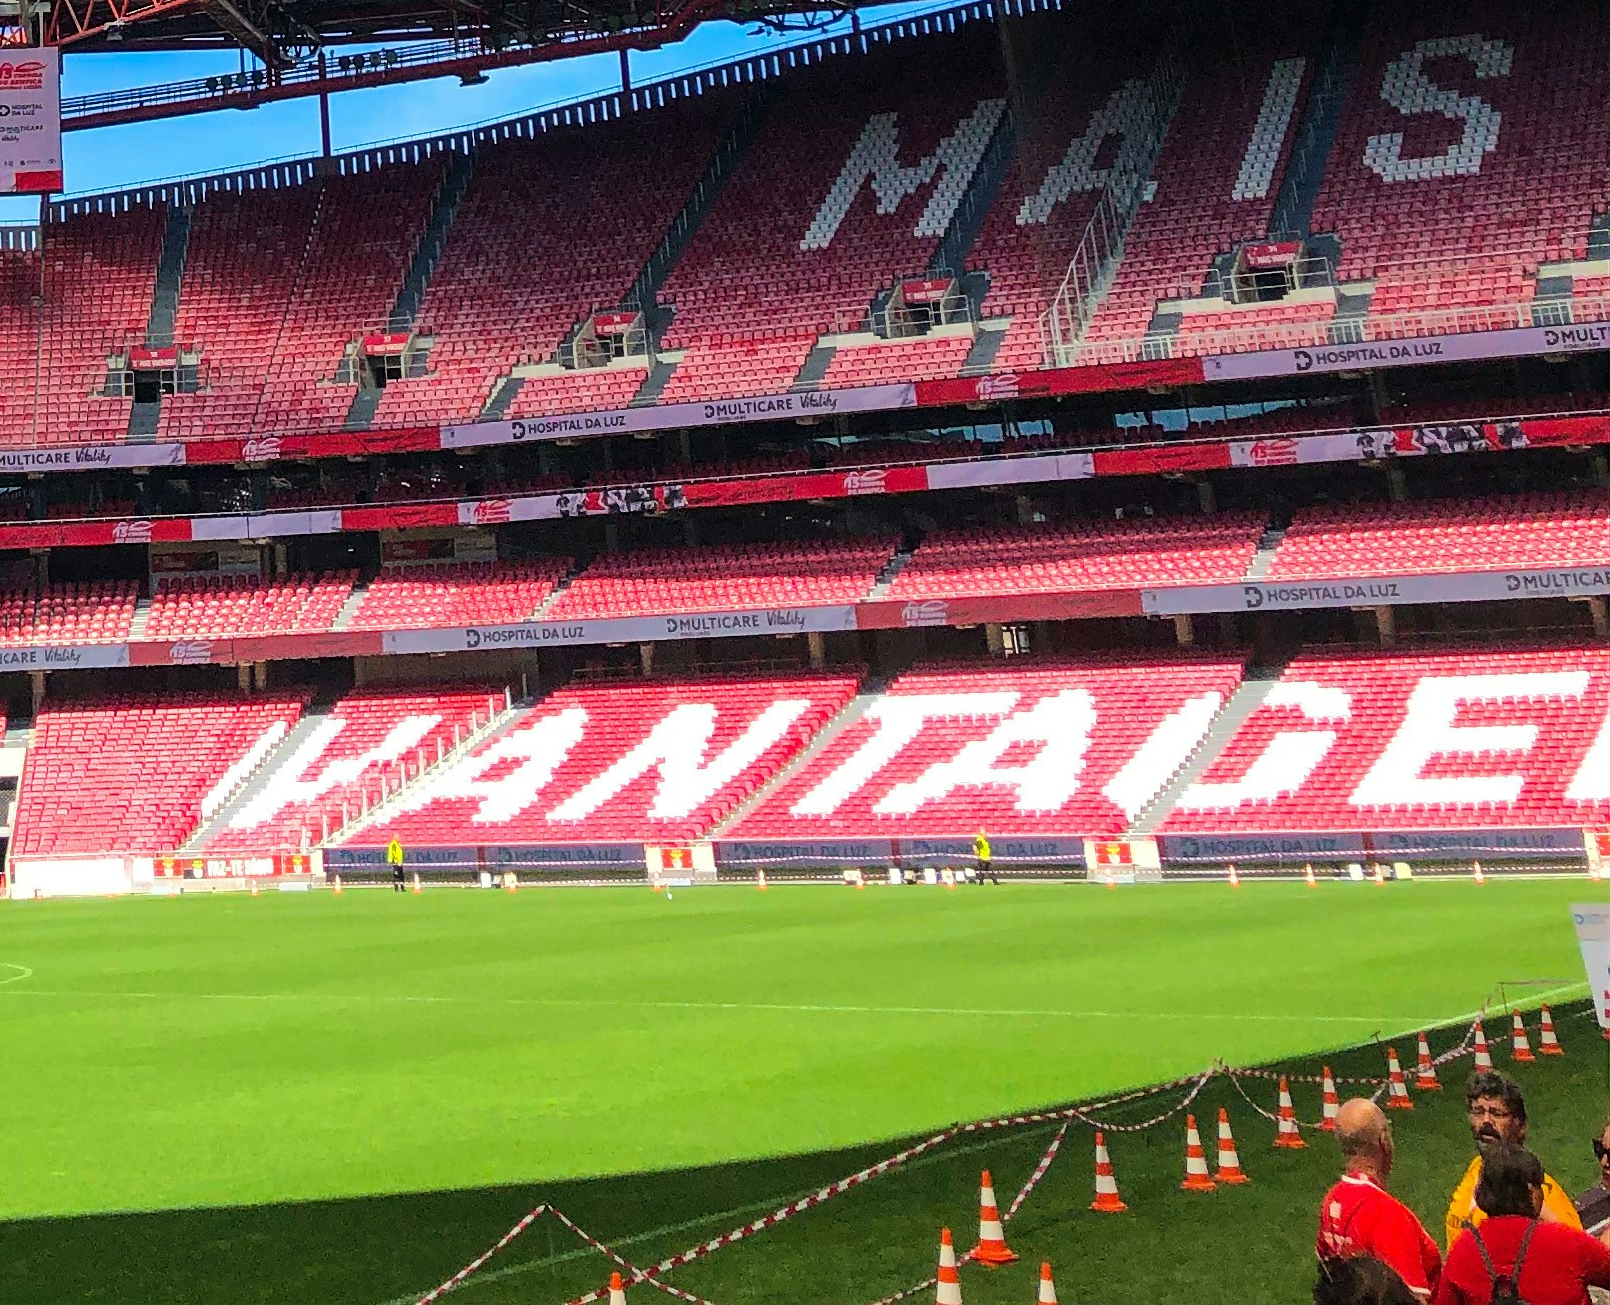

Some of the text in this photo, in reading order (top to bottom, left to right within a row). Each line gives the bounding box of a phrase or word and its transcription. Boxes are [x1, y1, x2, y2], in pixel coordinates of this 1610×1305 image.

[800, 33, 1515, 252] MAIS
[1562, 327, 1610, 344] MULT
[1316, 343, 1443, 365] HOSPITAL DA LUZ
[716, 394, 839, 416] MULTICARE Vitality
[528, 416, 626, 434] HOSPITAL DA LUZ
[75, 449, 112, 469] Vitality
[1267, 583, 1399, 601] HOSPITAL DA LUZ
[680, 609, 806, 629] MULTICARE Vitality
[483, 626, 585, 643] HOSPITAL DA LUZ
[45, 648, 82, 665] Vitality
[208, 857, 244, 876] FAZ-TE
